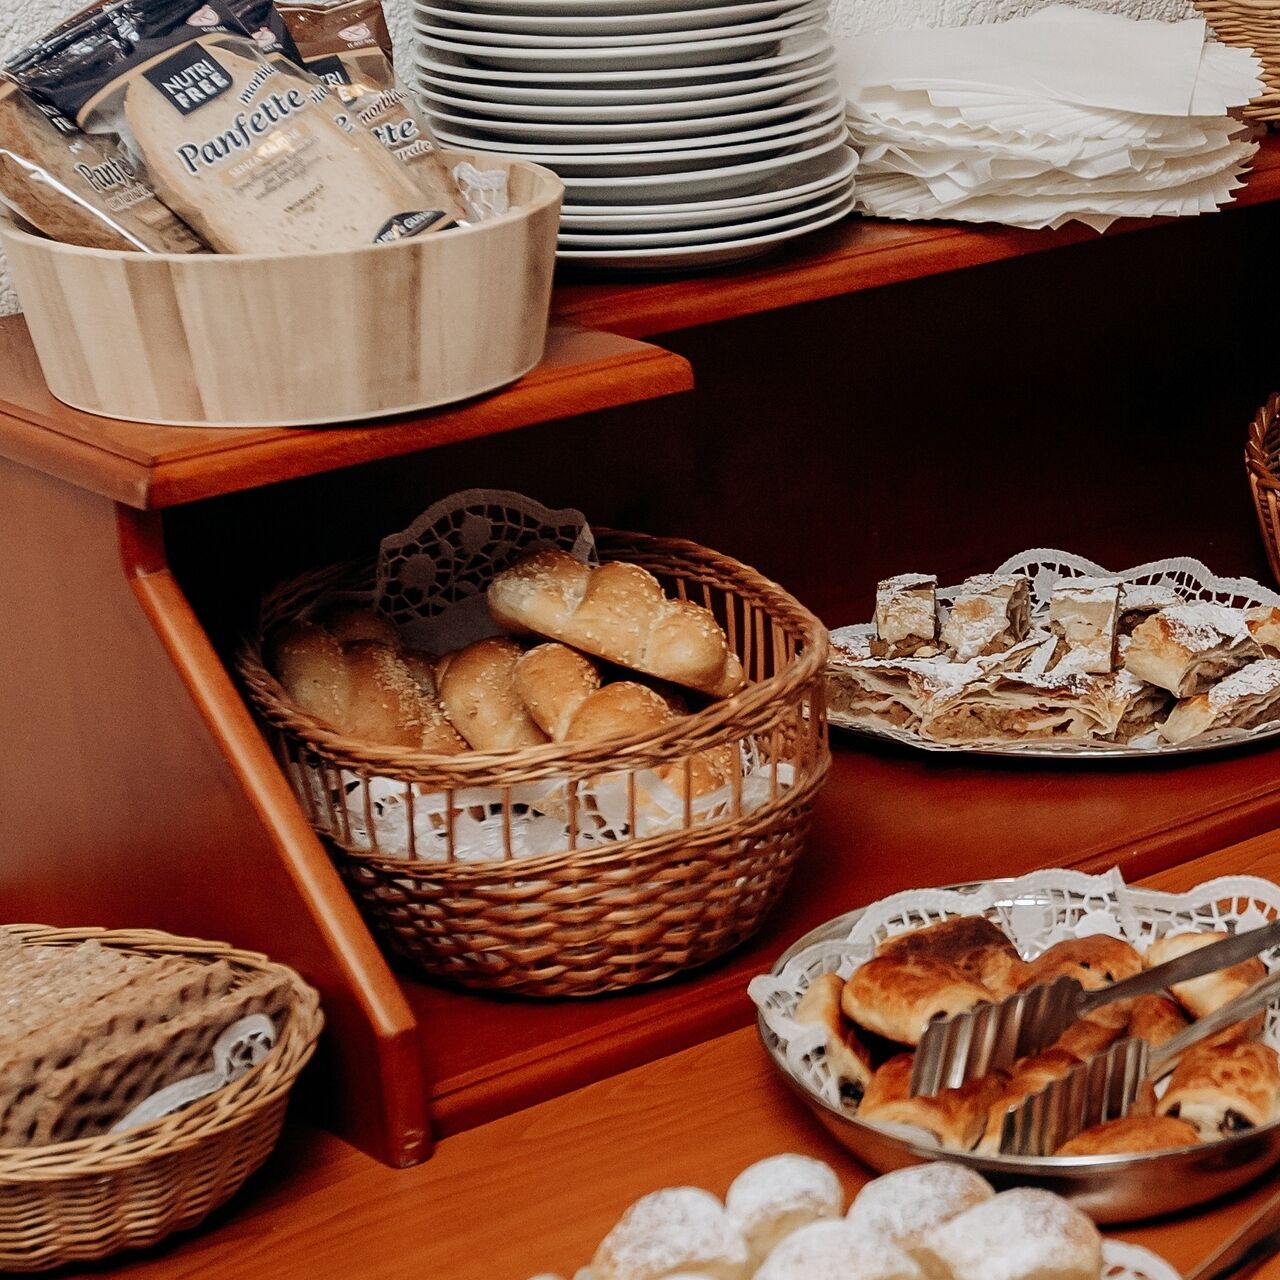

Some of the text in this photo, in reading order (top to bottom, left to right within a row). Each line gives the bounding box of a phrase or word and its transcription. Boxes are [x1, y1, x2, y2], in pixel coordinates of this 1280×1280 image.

[161, 59, 216, 95] NUTRI
[174, 72, 229, 108] FREE
[176, 89, 305, 173] Panfette
